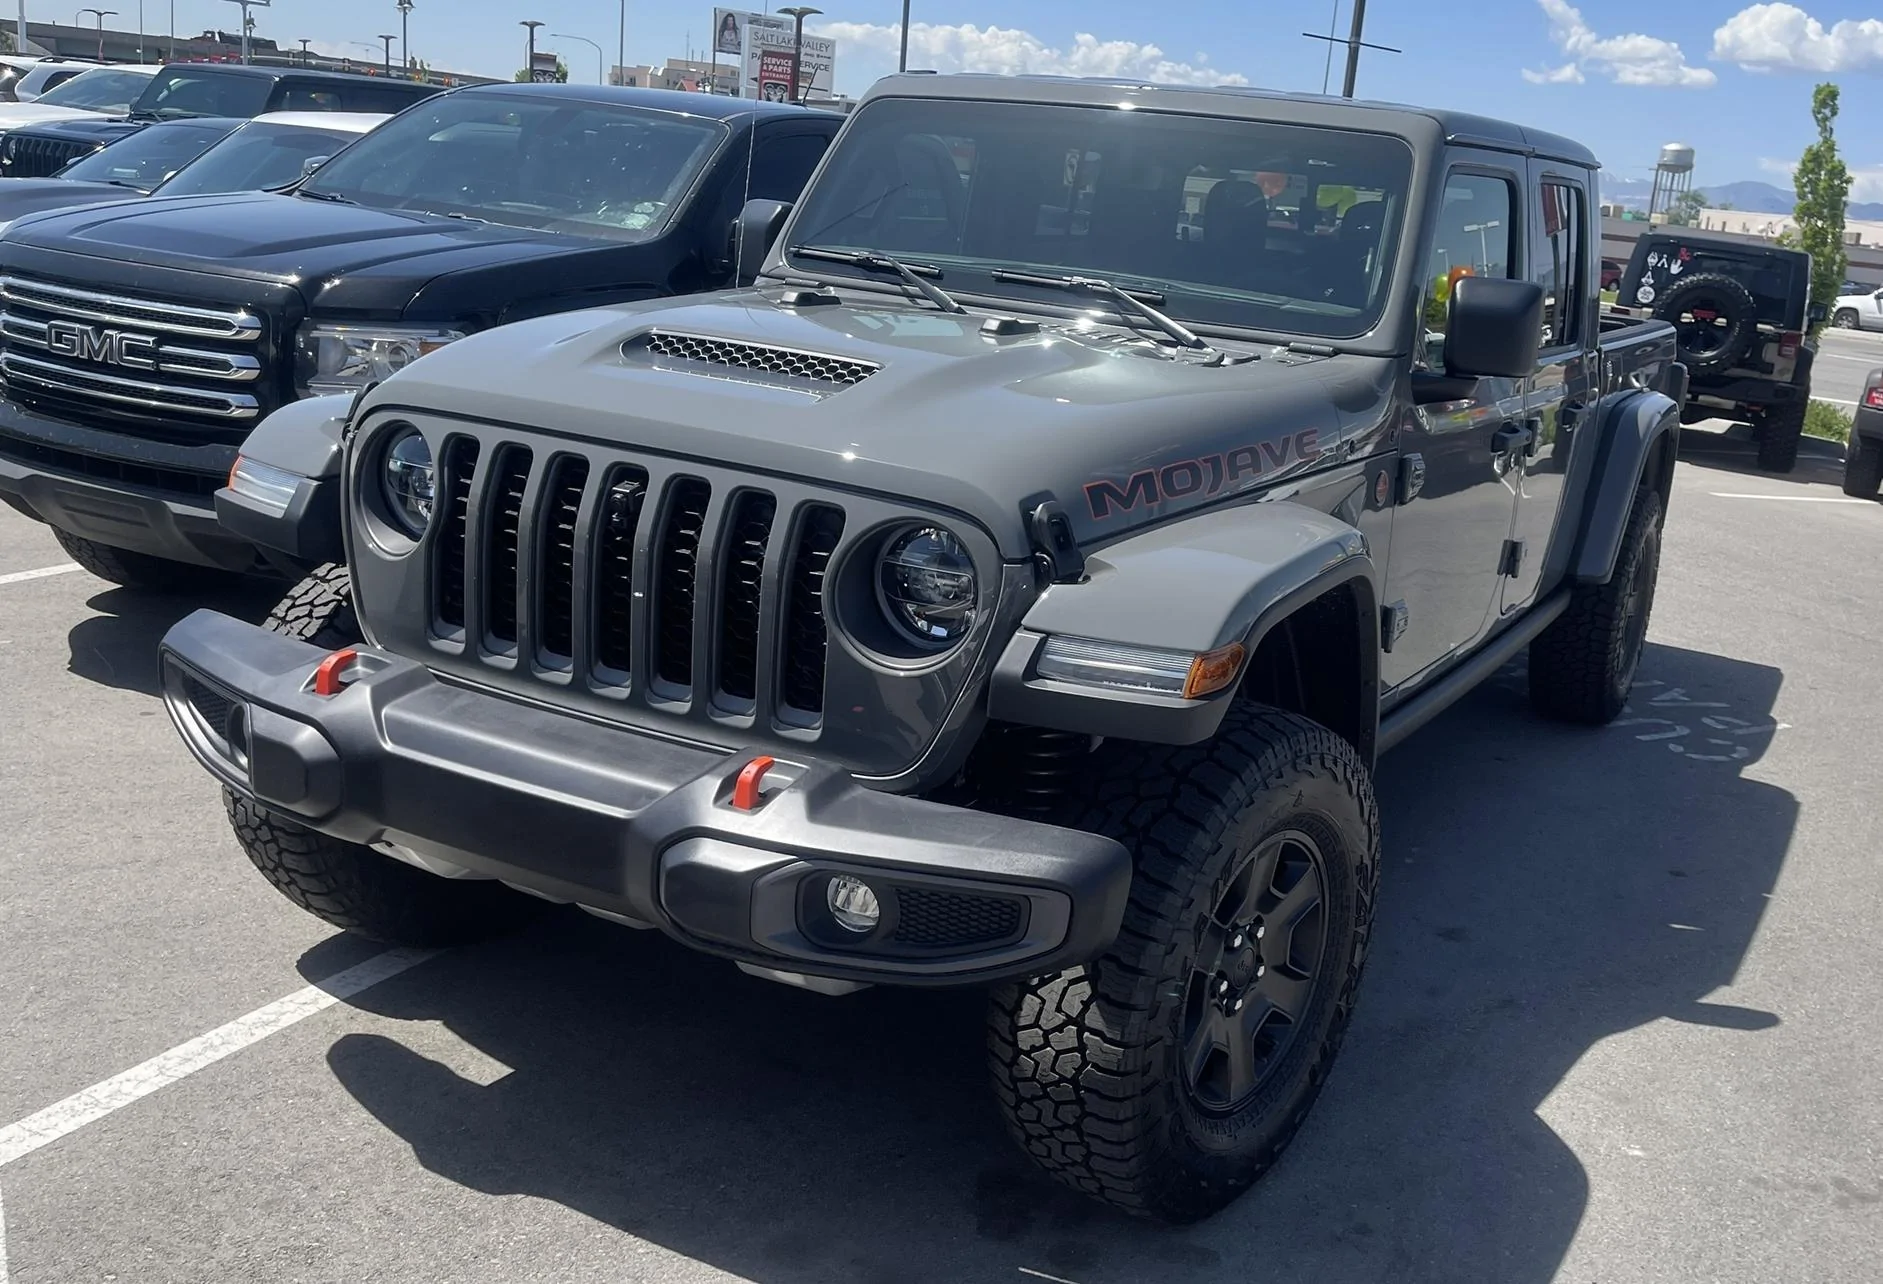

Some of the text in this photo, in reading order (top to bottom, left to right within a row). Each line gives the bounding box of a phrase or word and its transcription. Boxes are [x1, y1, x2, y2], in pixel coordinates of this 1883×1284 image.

[753, 32, 775, 43] SALT
[801, 40, 831, 53] VALLEY
[763, 56, 793, 67] SERVICE
[799, 60, 831, 72] ERVICE
[768, 64, 792, 74] PARTS
[761, 71, 791, 80] ENTRANCE
[47, 320, 158, 371] GMC
[1082, 427, 1323, 521] MOJAVE
